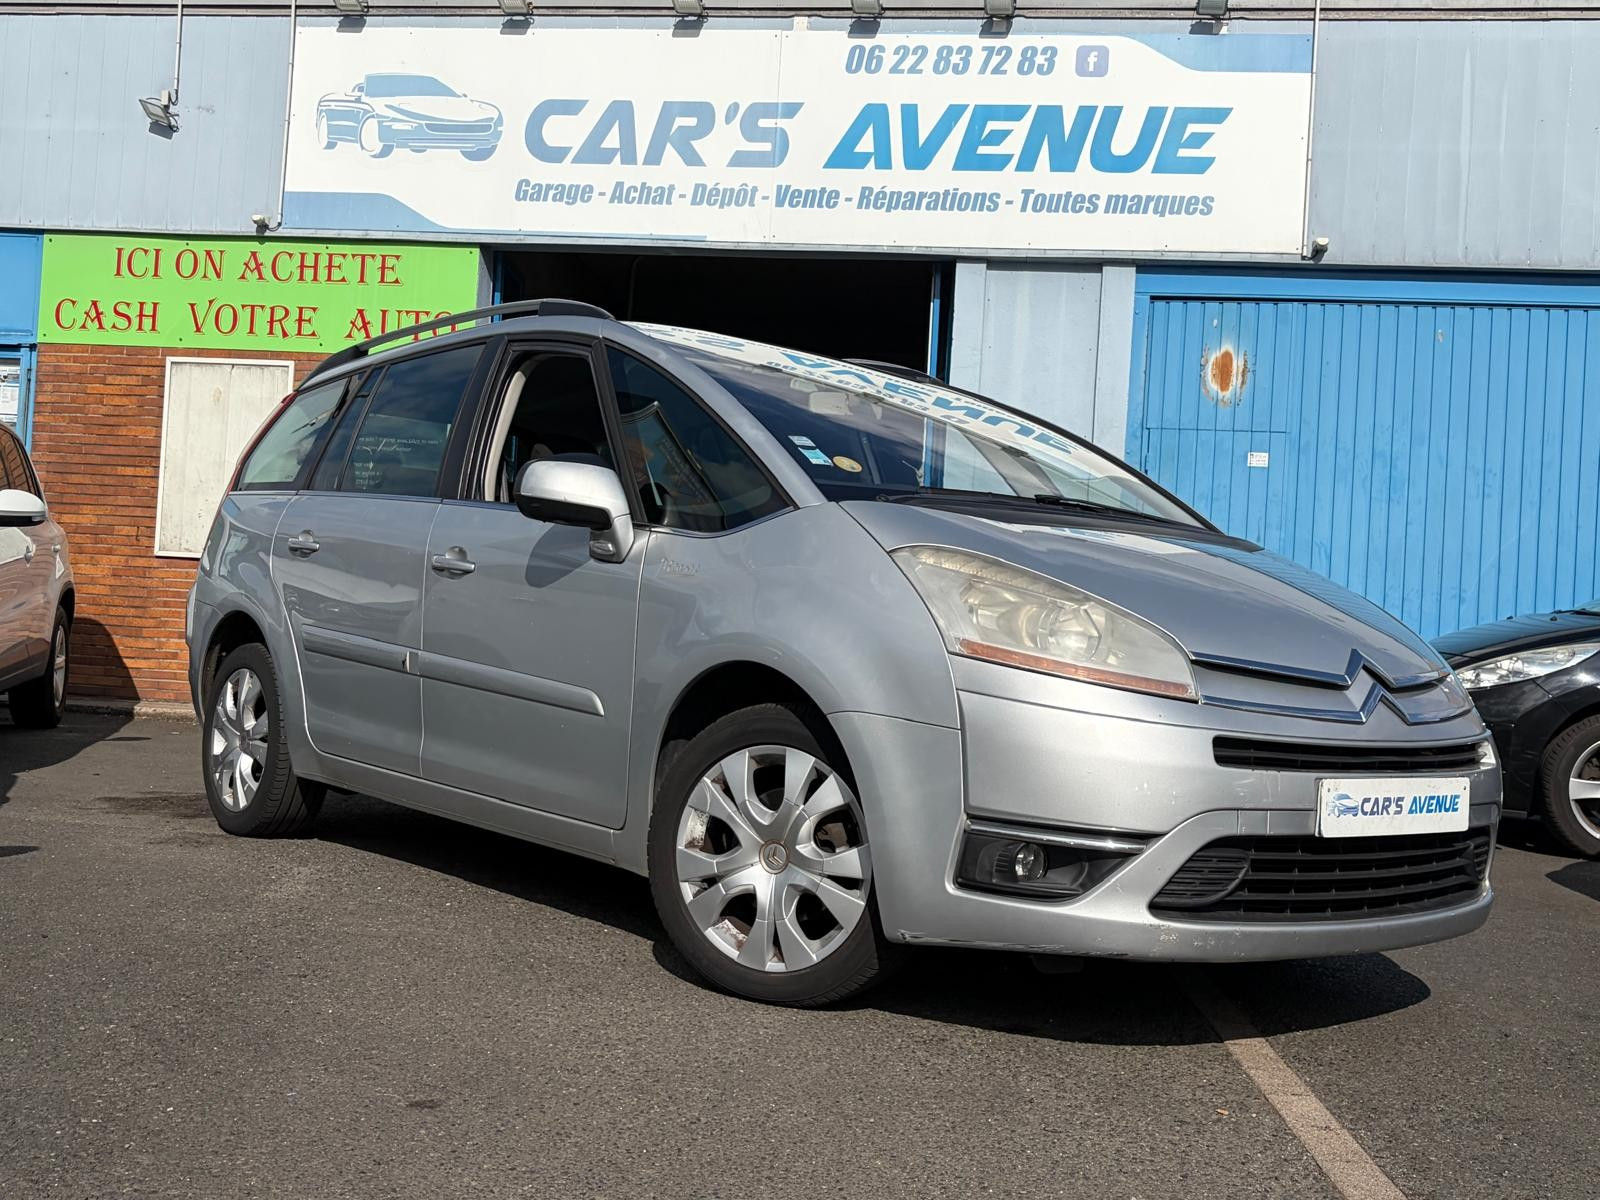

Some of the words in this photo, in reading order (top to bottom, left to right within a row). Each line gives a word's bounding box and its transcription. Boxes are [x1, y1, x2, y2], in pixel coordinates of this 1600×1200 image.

[845, 45, 886, 74] 06
[889, 45, 929, 75] 22
[932, 45, 973, 75] 83
[979, 46, 1013, 75] 72
[1017, 46, 1058, 76] 83
[524, 99, 804, 167] CAR'S
[822, 102, 1234, 175] AVENUE
[515, 179, 594, 205] Garage
[609, 181, 675, 205] Achat
[690, 182, 758, 208] Dépôt
[775, 185, 840, 209] Vente
[857, 185, 1000, 213] Réparations
[1020, 188, 1099, 214] Toutes
[1103, 193, 1214, 217] marques
[113, 247, 163, 279] ICI
[175, 249, 225, 281] ON
[239, 250, 403, 286] ACHETE
[54, 298, 160, 333] CASH
[188, 298, 320, 339] VOTRE
[1360, 796, 1405, 817] CAR'S
[1407, 794, 1461, 815] AVENUE
